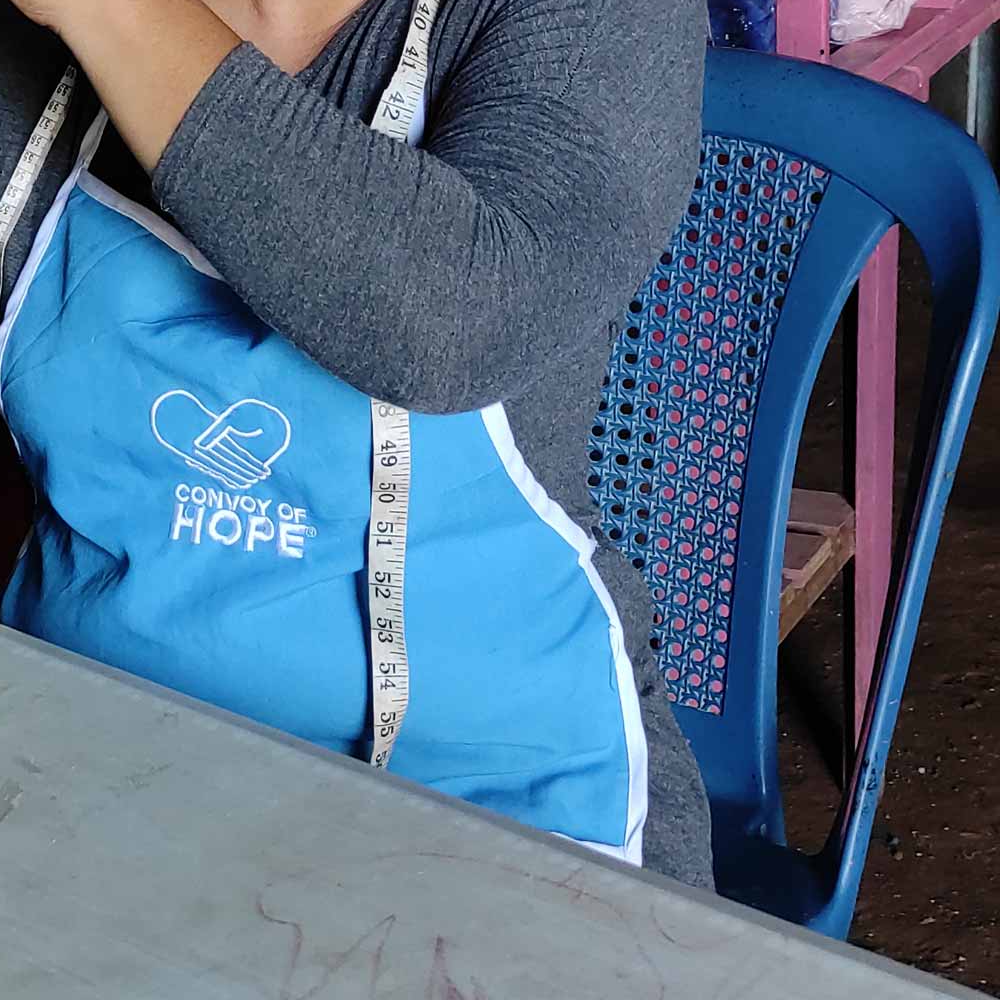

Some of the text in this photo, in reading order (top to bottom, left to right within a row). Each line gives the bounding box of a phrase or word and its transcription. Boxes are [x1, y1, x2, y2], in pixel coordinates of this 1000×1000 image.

[414, 2, 431, 31] 40
[402, 45, 419, 70] 41
[383, 91, 405, 120] 42
[380, 440, 397, 467] 49
[175, 484, 307, 523] CONVOY OF
[378, 482, 396, 504] 50
[376, 521, 393, 547] 51
[375, 571, 391, 599] 52
[376, 617, 393, 643] 53
[379, 662, 396, 690] 54
[380, 711, 396, 737] 55
